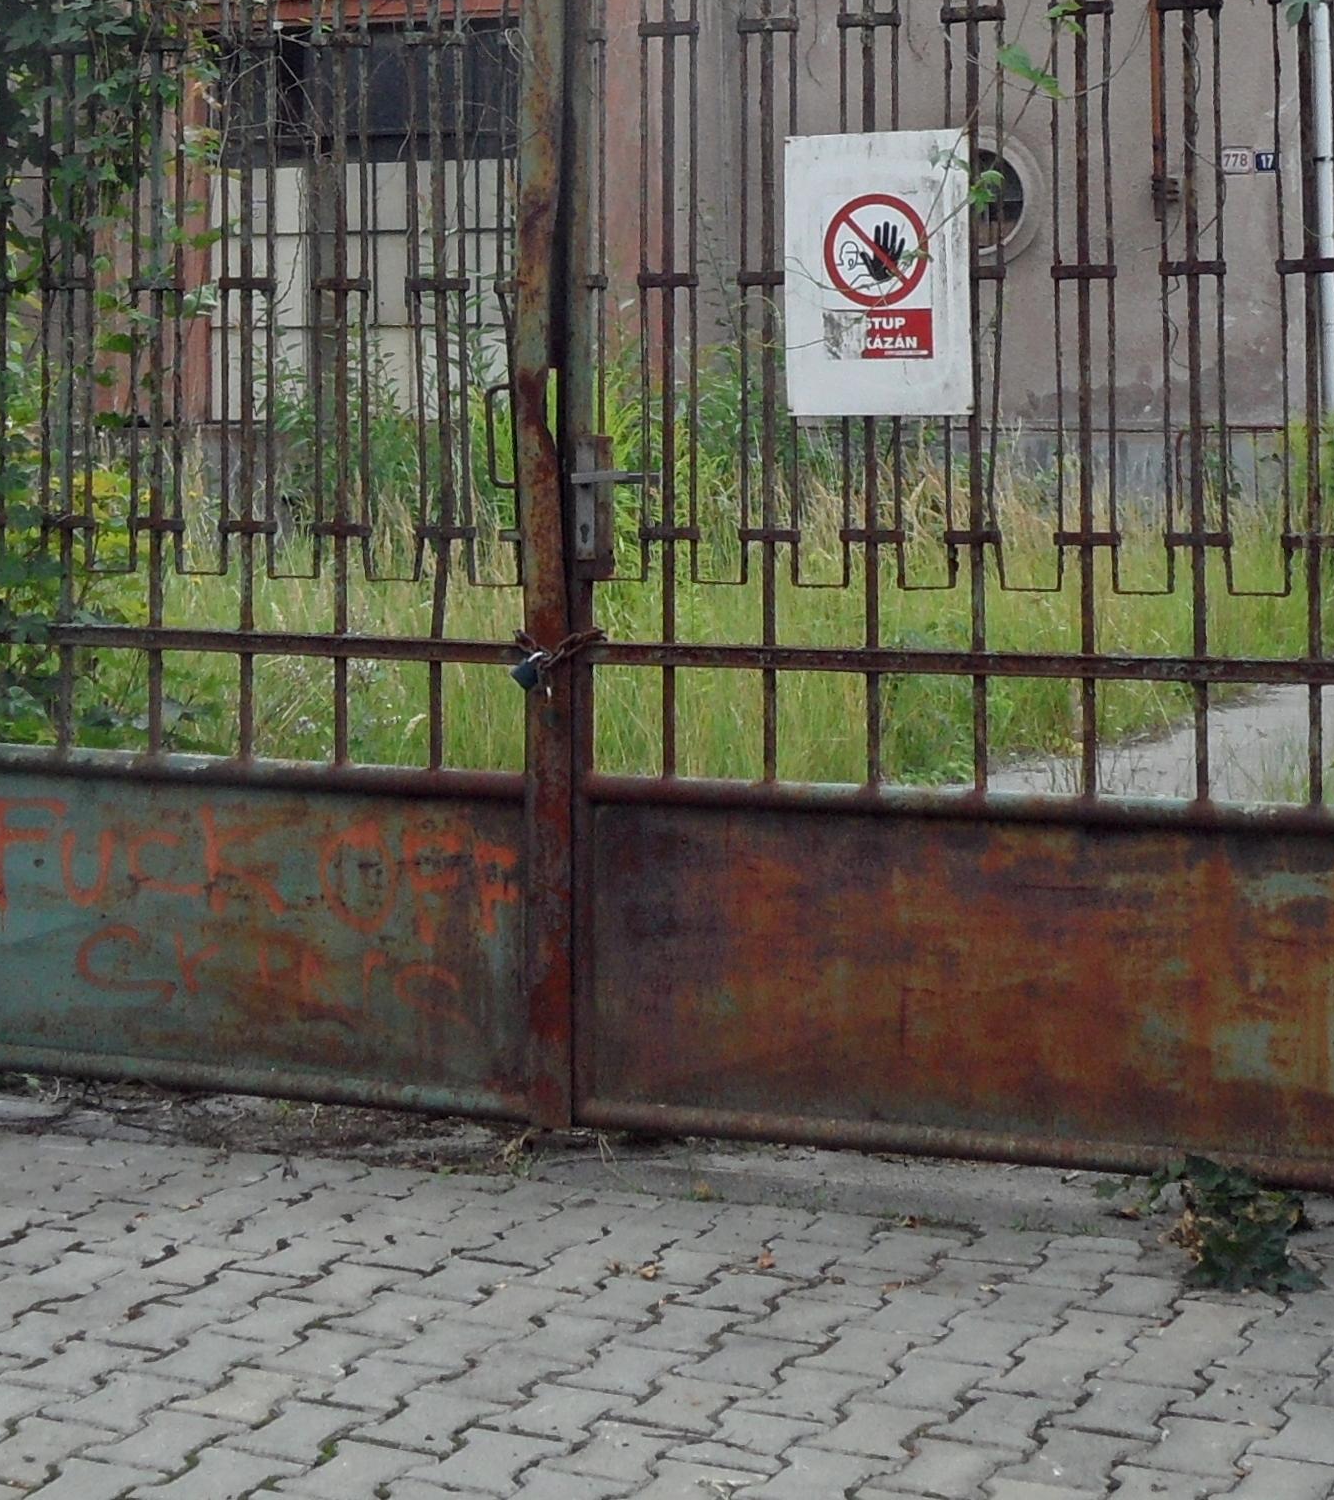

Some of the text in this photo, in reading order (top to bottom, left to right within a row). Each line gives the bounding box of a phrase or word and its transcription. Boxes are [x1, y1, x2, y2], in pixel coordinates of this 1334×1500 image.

[1223, 153, 1248, 167] 778
[1260, 154, 1274, 169] 17
[864, 316, 906, 330] STUP
[861, 333, 918, 350] KÁZÁN
[319, 820, 522, 945] OFF
